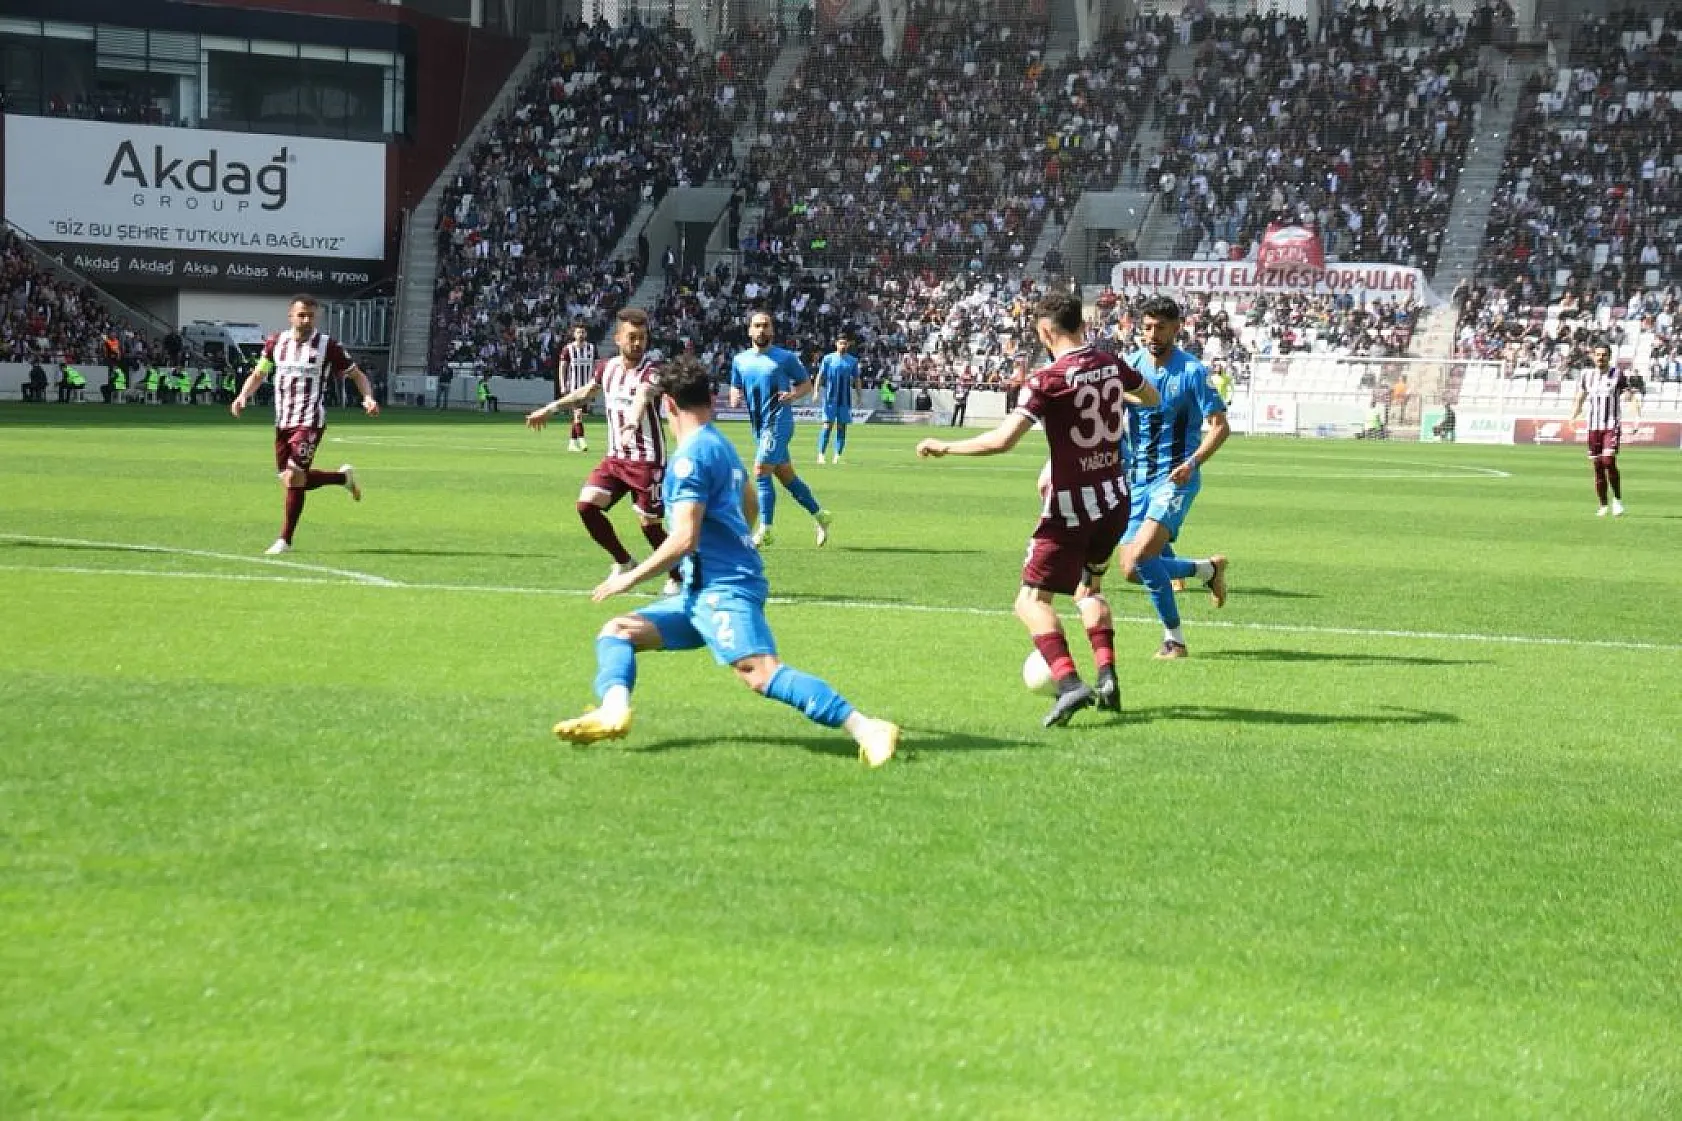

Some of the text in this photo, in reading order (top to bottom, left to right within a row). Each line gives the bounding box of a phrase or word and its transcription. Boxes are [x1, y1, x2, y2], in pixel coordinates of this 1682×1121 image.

[104, 140, 287, 211] Akdağ
[133, 194, 249, 213] GROUP
[89, 223, 112, 238] BU
[117, 224, 168, 241] ŞEHRE
[175, 228, 261, 246] TUTKUYLA
[1122, 263, 1224, 291] MİLLİYETÇİ
[1069, 378, 1124, 449] 33
[713, 611, 735, 649] 2
